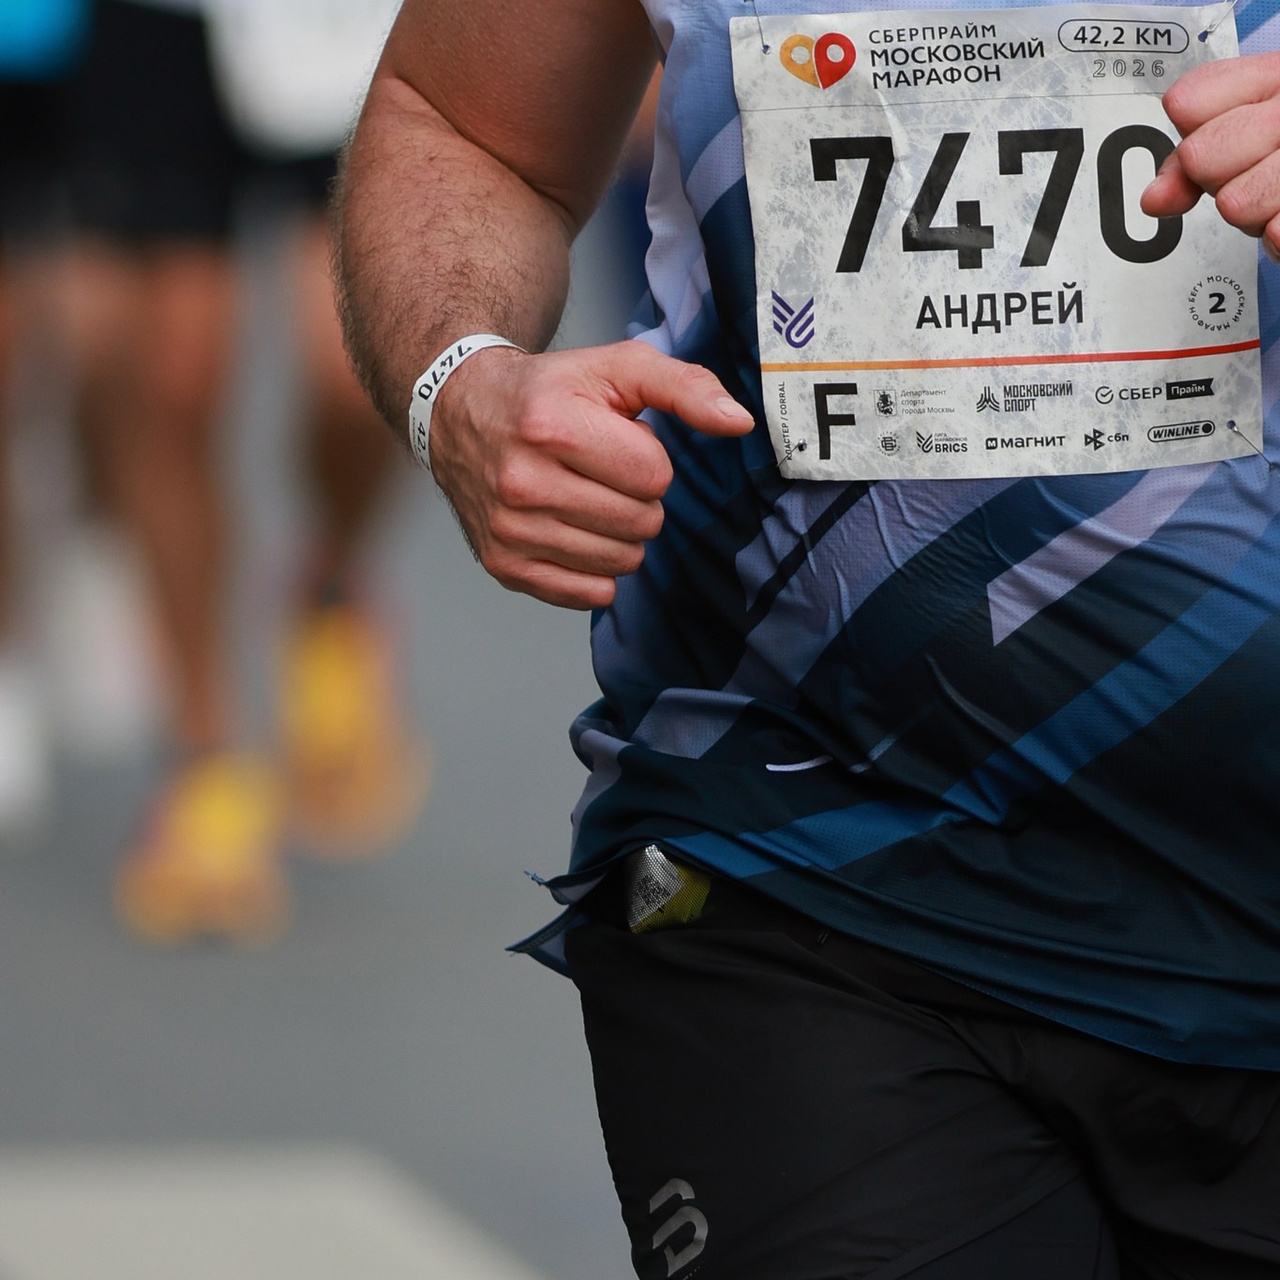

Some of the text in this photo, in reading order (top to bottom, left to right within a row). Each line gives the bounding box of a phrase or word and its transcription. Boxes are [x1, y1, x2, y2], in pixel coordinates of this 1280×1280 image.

[868, 22, 996, 44] СБЕРПРАЙМ
[1073, 26, 1125, 47] 42,2
[870, 37, 1045, 67] МОСКОВСКИЙ
[872, 64, 1001, 90] МАРАФОН
[1092, 59, 1165, 78] 2026
[809, 123, 1184, 273] 7470
[916, 281, 1084, 334] АНДРЕЙ
[1188, 275, 1245, 332] БЕГУ МОСКОВСКИЙ МАРАФОН
[1208, 292, 1226, 314] 2
[418, 344, 473, 401] 7470
[778, 381, 788, 415] CORRAL
[1003, 380, 1073, 398] МОСКОВСКИЙ
[1118, 384, 1206, 400] СБЕР Прайм
[1004, 398, 1036, 412] СПОРТ
[813, 382, 858, 461] F
[1153, 424, 1200, 439] WINLINE
[782, 422, 792, 460] КЛАСТЕР
[934, 442, 968, 453] BRICS
